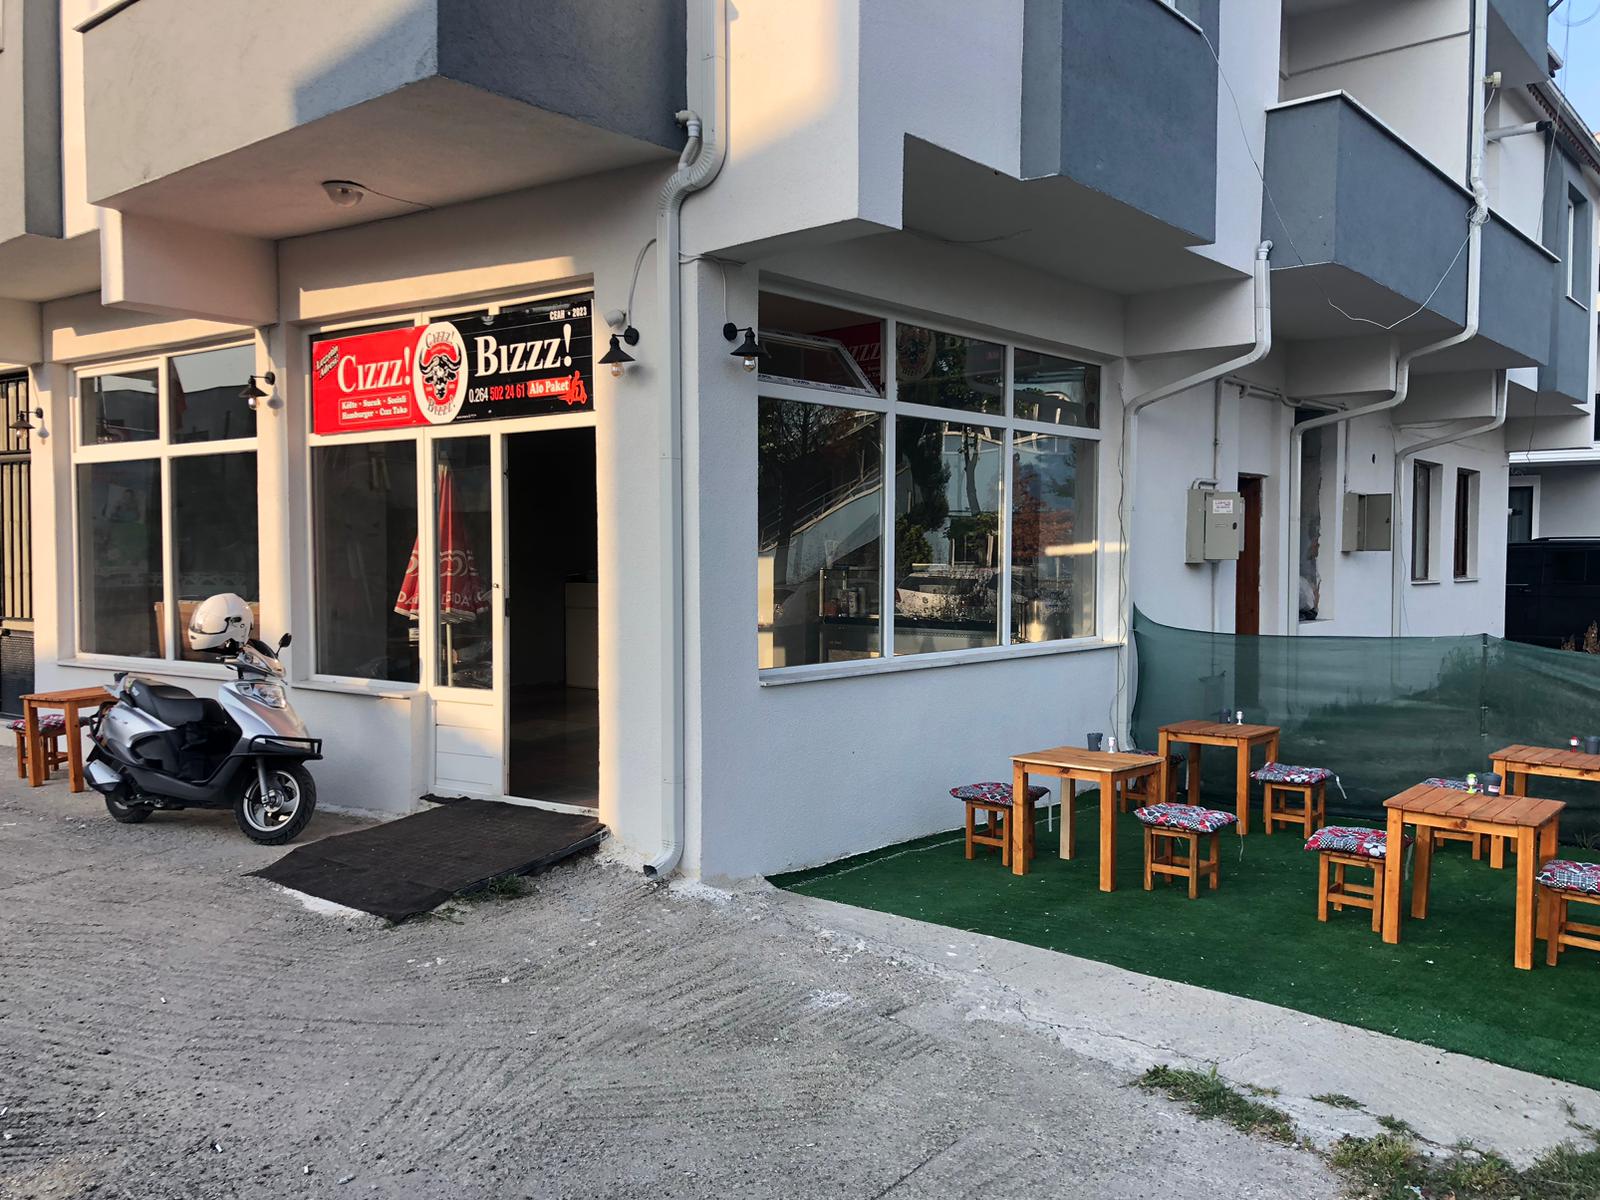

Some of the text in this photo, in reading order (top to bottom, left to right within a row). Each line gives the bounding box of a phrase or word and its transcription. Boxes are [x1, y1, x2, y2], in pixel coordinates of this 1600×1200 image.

[572, 306, 588, 318] 2023
[468, 383, 525, 403] 0.264 502 24 61
[545, 379, 570, 393] Paket
